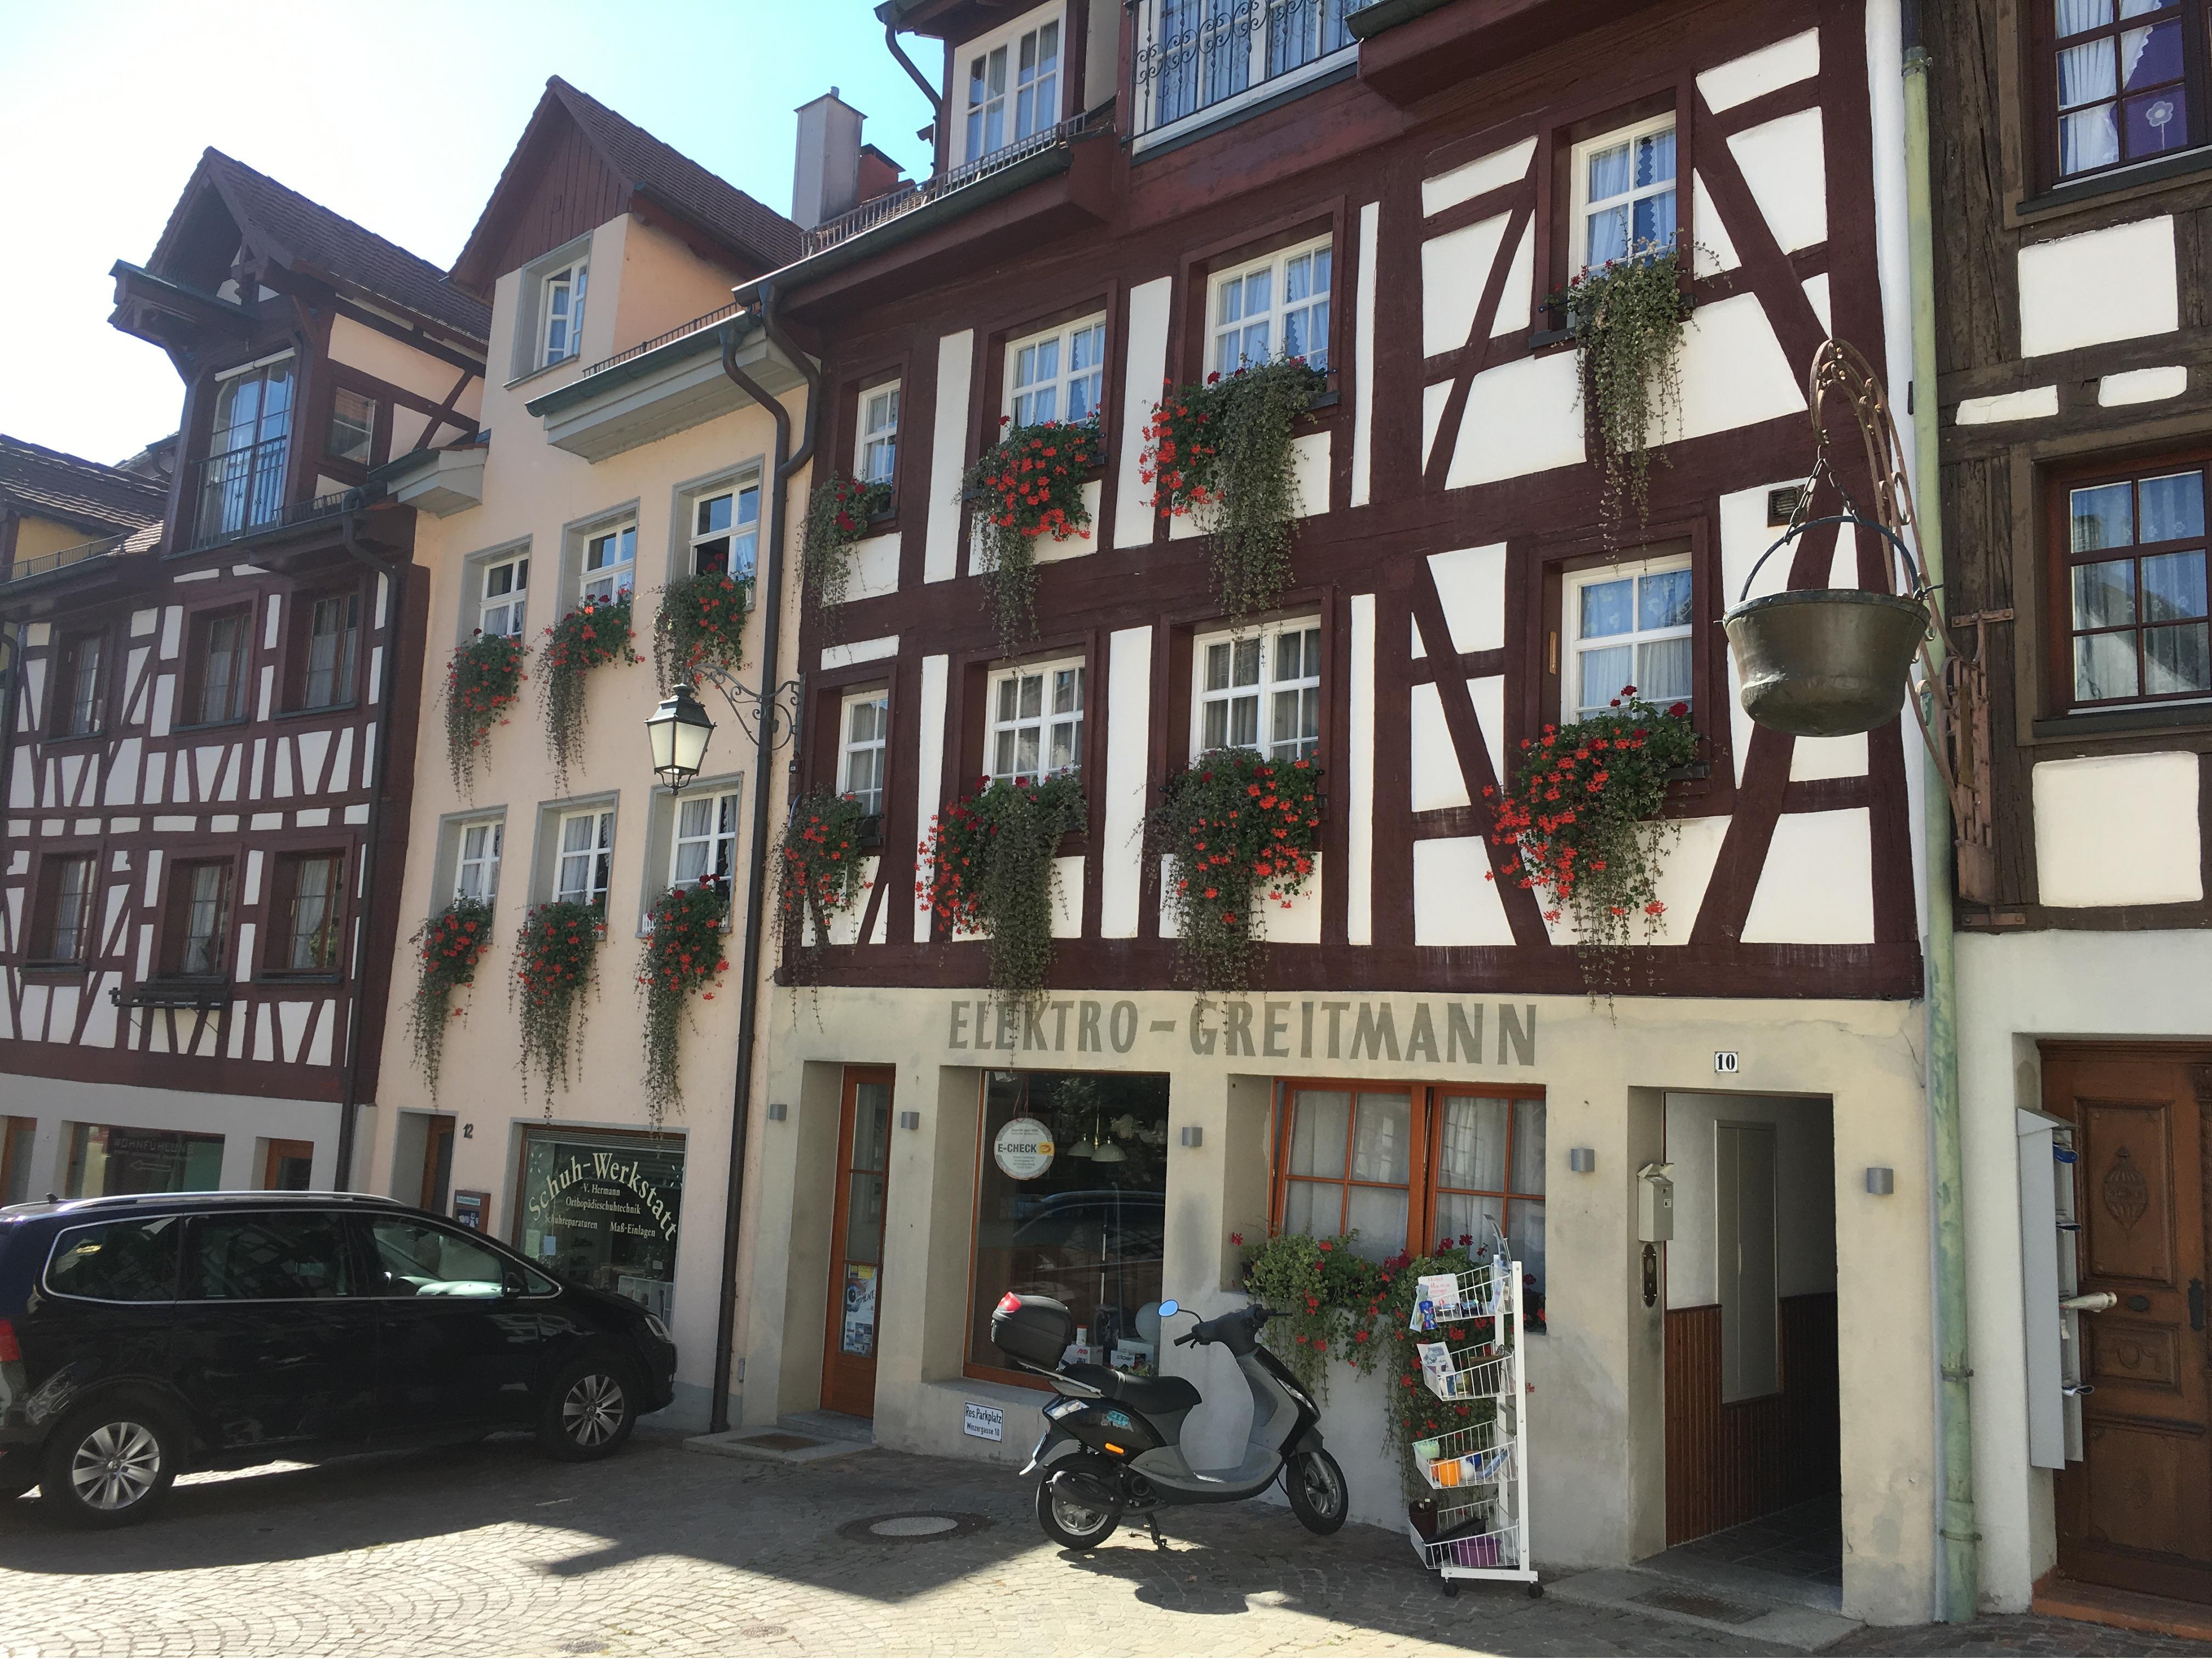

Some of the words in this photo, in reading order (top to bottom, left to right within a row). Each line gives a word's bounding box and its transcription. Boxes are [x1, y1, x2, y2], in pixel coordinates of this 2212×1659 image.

[1717, 1053, 1735, 1070] 10
[463, 1123, 474, 1139] 12
[997, 1143, 1037, 1153] E-CHECK
[528, 1153, 676, 1242] Schuh-Werkstatt
[592, 1185, 620, 1197] Hermann
[566, 1196, 641, 1215] Orthopädieschuhtechnik
[544, 1214, 598, 1229] Schuhreparaturen
[610, 1222, 656, 1238] Maß-Einlagen
[967, 1422, 994, 1435] Winzergasse
[995, 1428, 1000, 1436] 10
